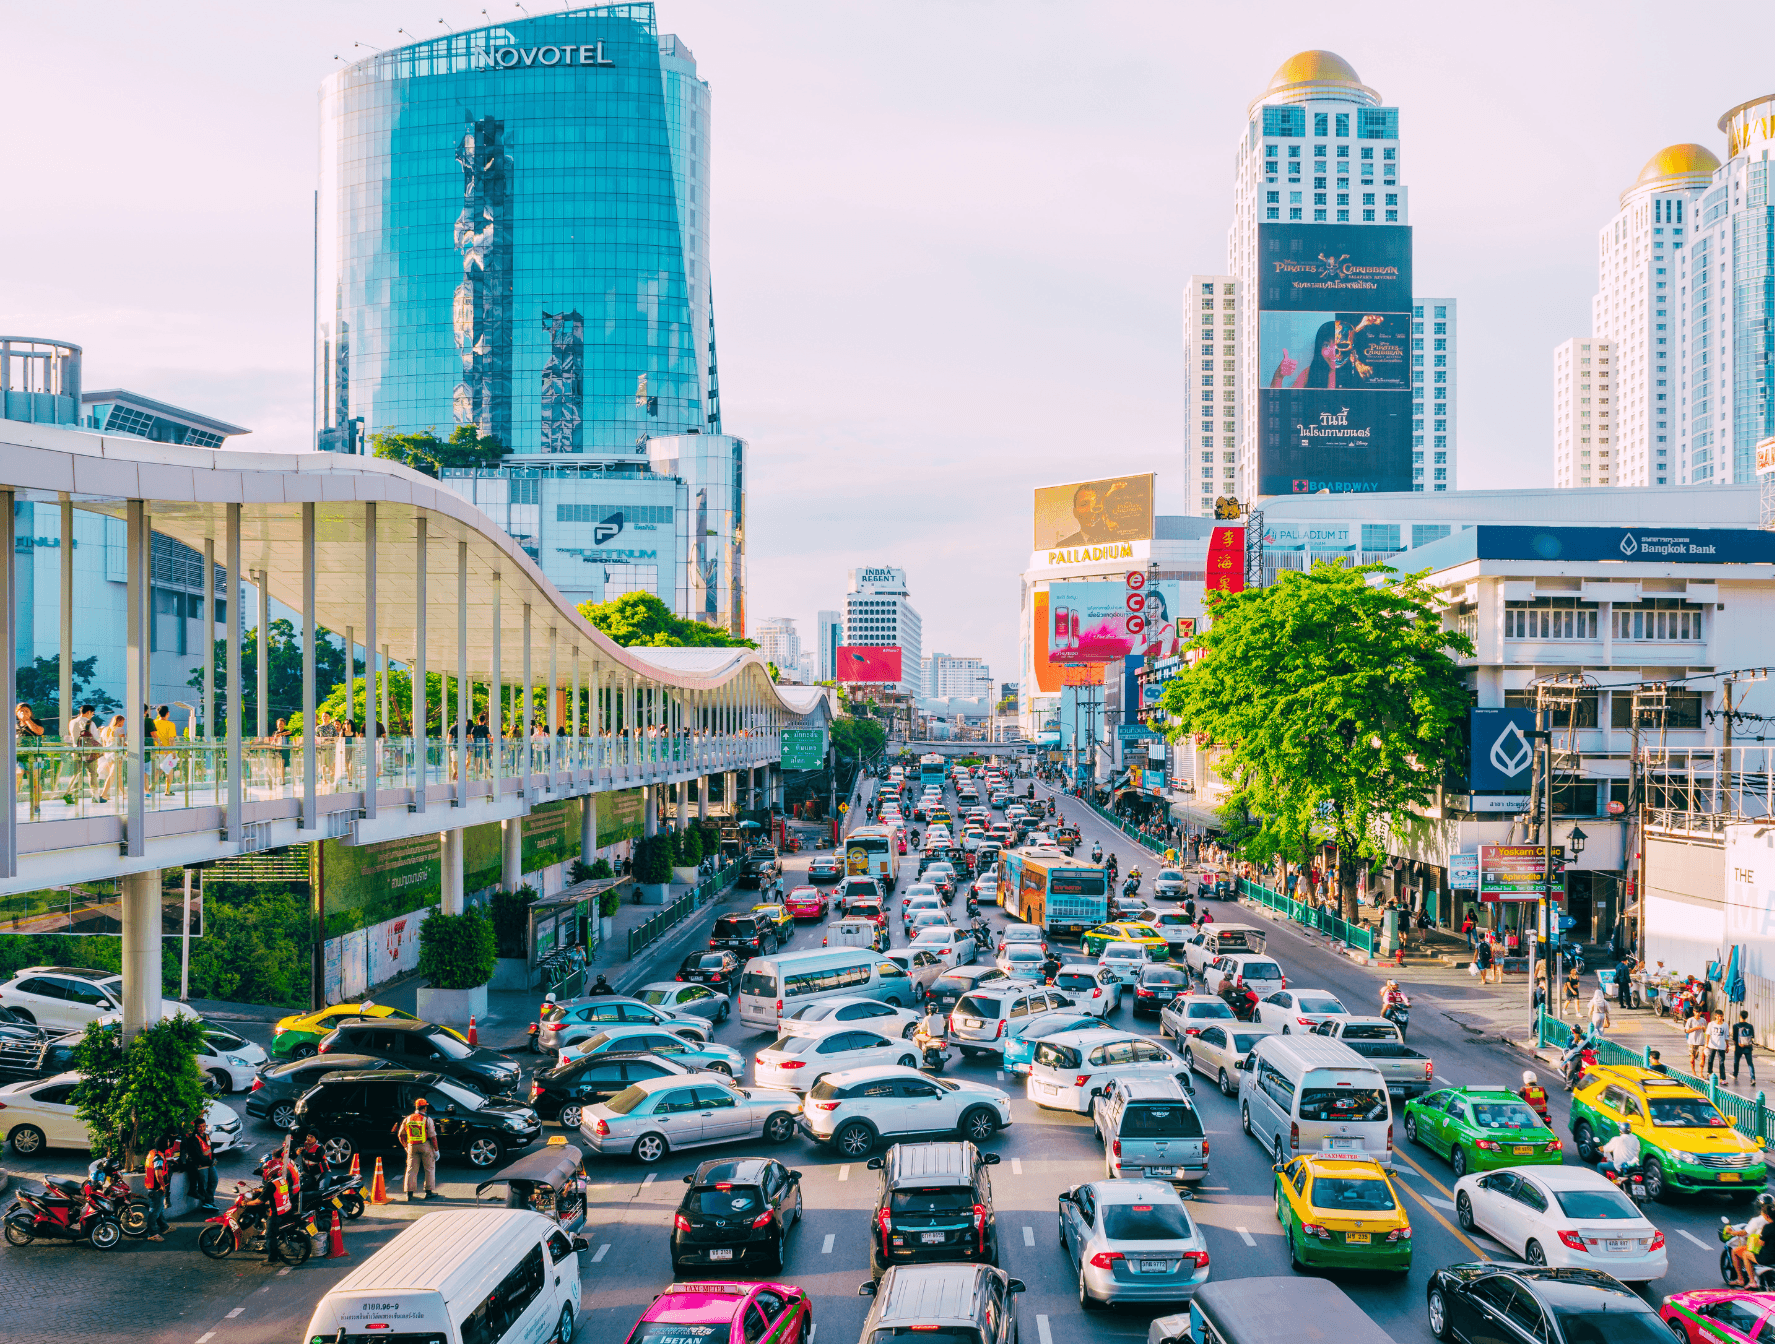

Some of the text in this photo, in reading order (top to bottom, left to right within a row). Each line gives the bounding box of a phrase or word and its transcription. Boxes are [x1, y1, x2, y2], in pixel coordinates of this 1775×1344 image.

[474, 41, 613, 67] NOVOTEL
[1273, 262, 1317, 273] PIRATES
[1342, 263, 1399, 275] CARIBBEAN
[1319, 406, 1350, 426] วันนี้
[1309, 481, 1379, 492] BOARDWAY
[1280, 530, 1349, 540] PALLADIUM IT
[1048, 541, 1134, 565] PALLADIUM
[1640, 543, 1716, 555] Bangkok Bank
[1499, 847, 1534, 856] Yoskarn
[1502, 873, 1541, 881] Aphrodite
[1734, 867, 1755, 884] THE
[660, 1335, 703, 1344] ISETAN
